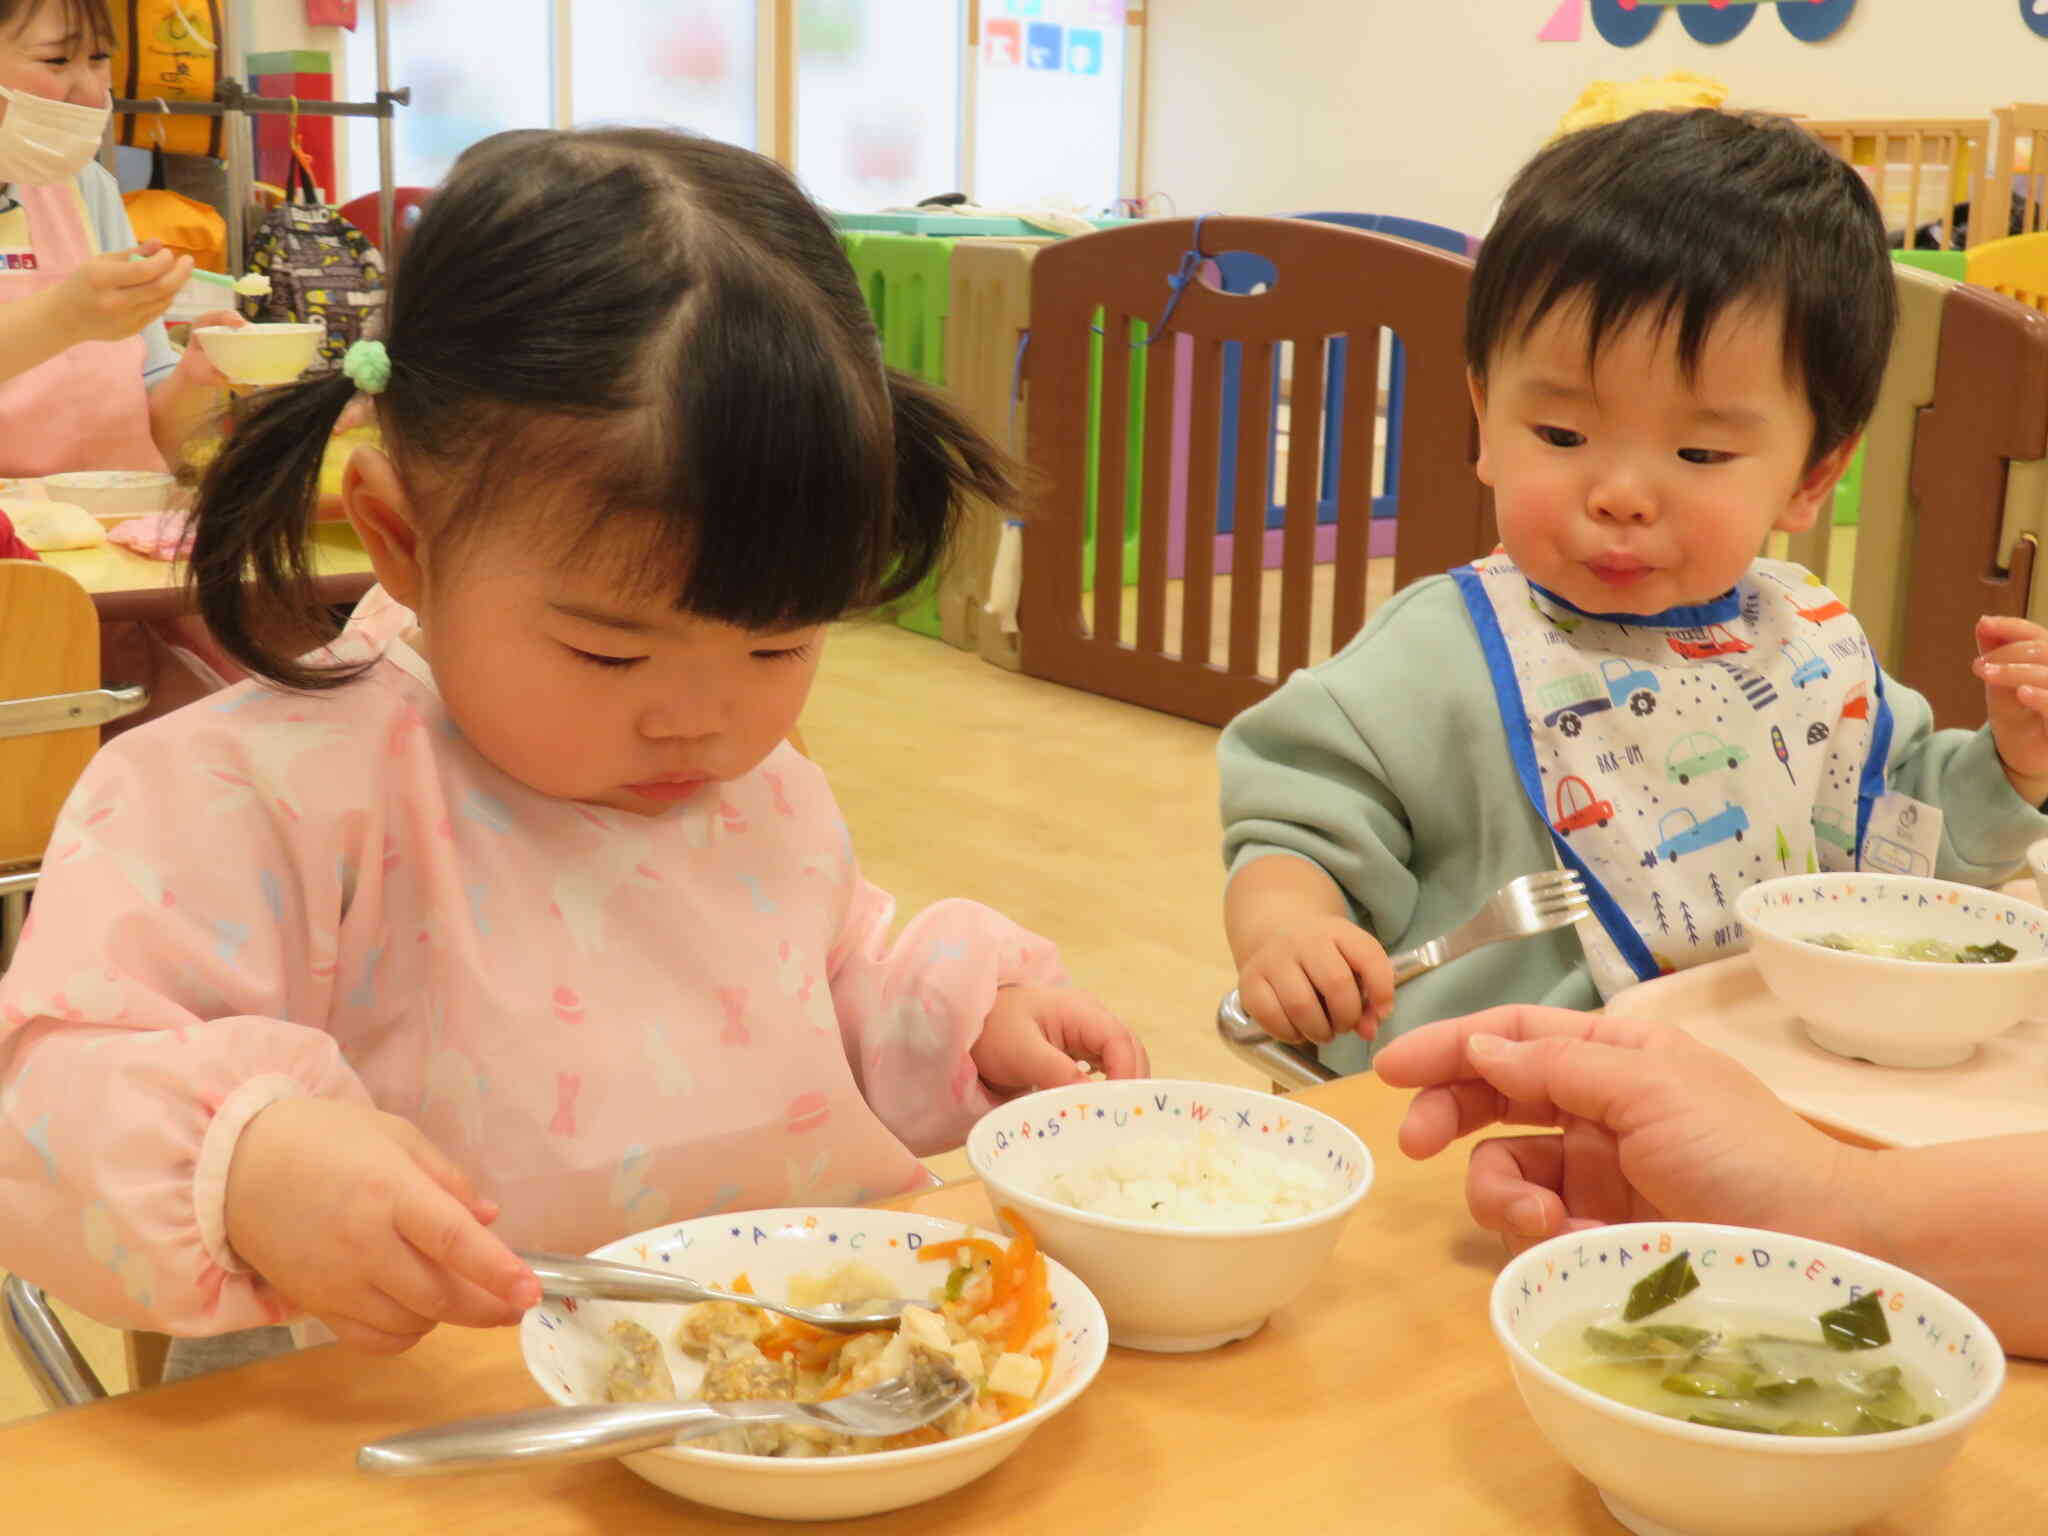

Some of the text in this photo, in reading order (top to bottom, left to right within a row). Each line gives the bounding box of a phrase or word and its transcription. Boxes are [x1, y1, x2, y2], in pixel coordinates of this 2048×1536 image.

[1917, 893, 1929, 909] A
[2005, 910, 2017, 926] D
[995, 1130, 1009, 1150] Q
[1020, 1121, 1032, 1140] R
[1047, 1117, 1061, 1137] S
[1075, 1103, 1090, 1121] T
[1114, 1109, 1128, 1128] U
[1153, 1094, 1168, 1112] V
[1191, 1100, 1213, 1121] W
[1235, 1109, 1252, 1129] X
[752, 1225, 768, 1247] A
[849, 1231, 867, 1250] C
[906, 1231, 923, 1251] D
[1618, 1247, 1634, 1268] A
[1658, 1231, 1673, 1254] B
[1701, 1248, 1718, 1268] C
[1751, 1248, 1771, 1269] D
[1805, 1258, 1826, 1281] E
[1849, 1285, 1864, 1302] F
[1888, 1292, 1906, 1313] G
